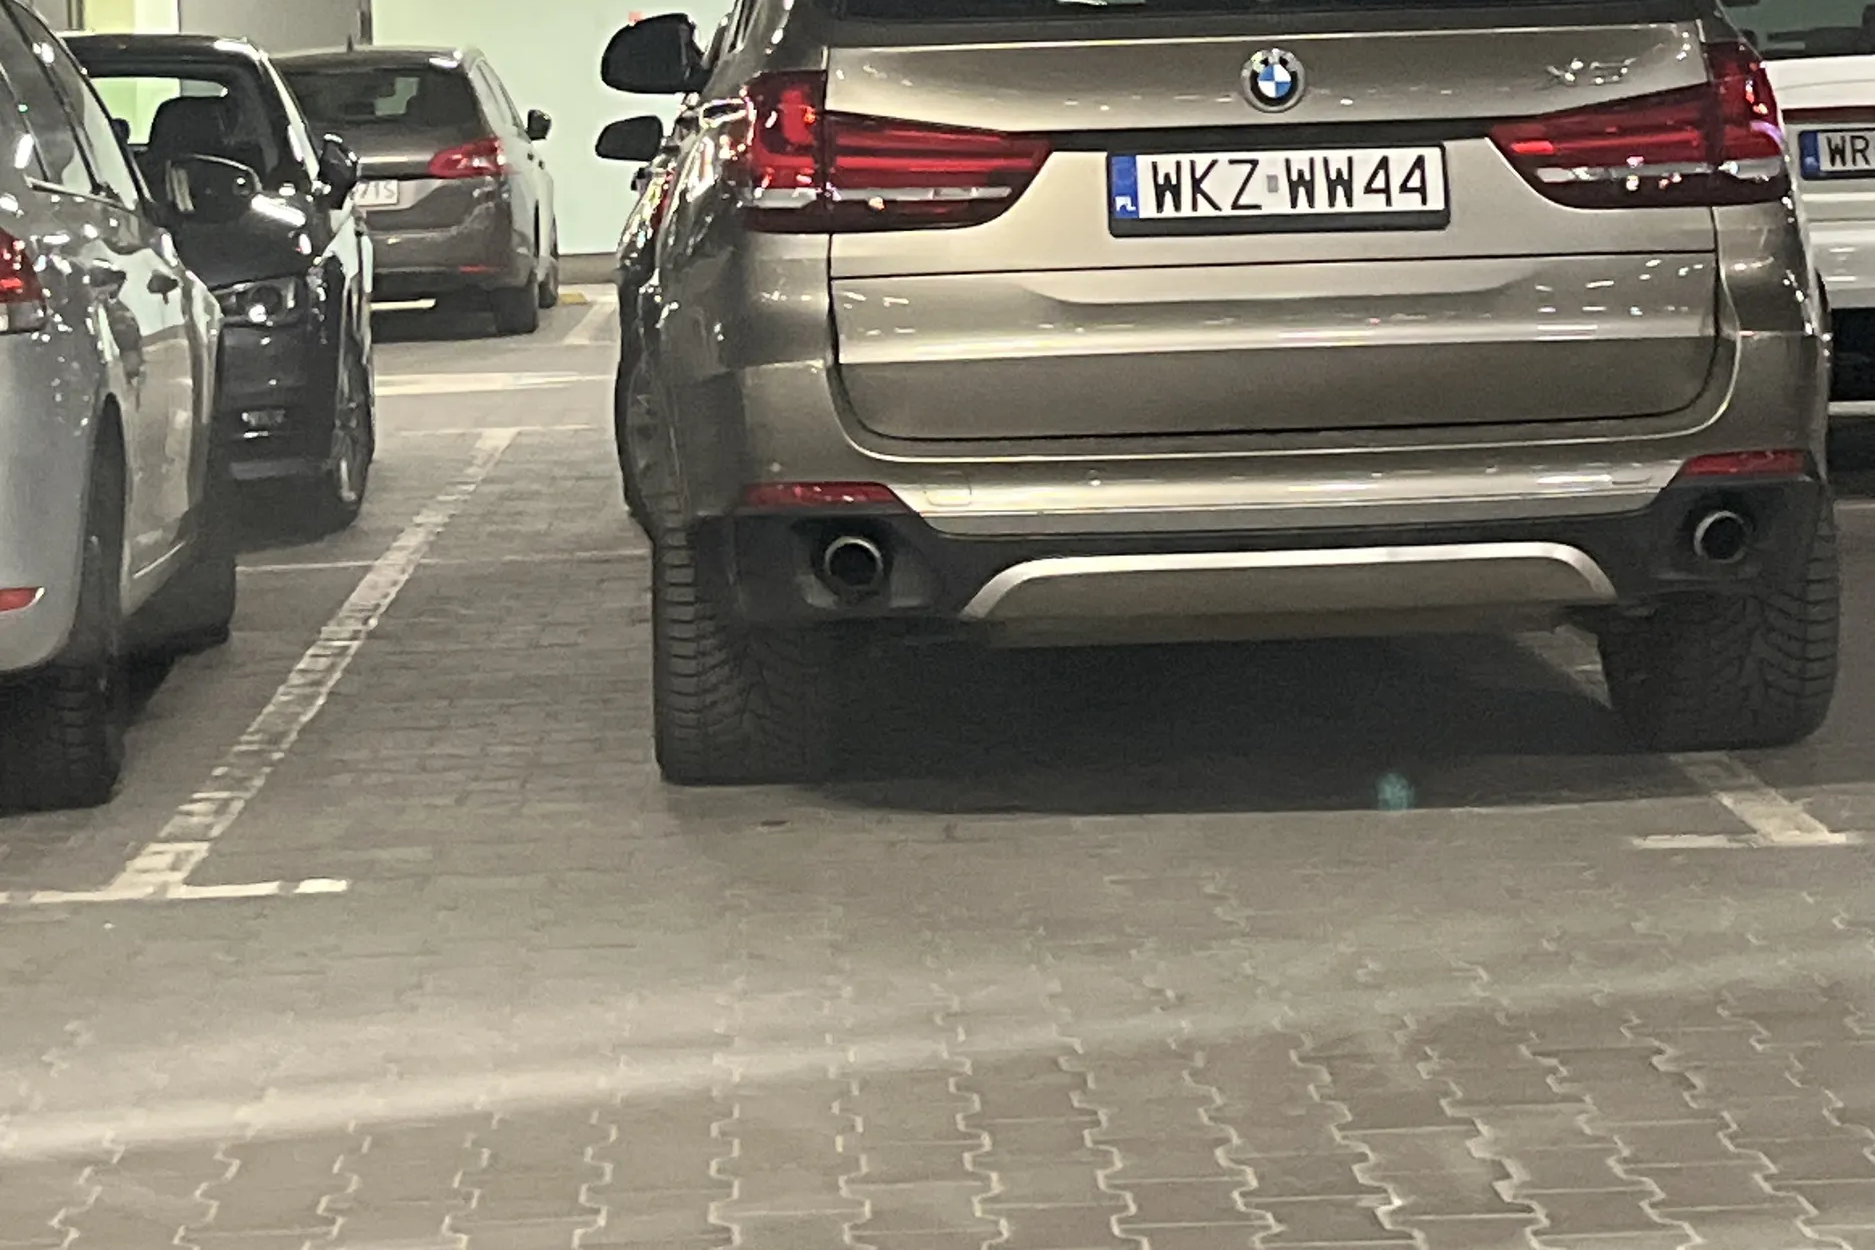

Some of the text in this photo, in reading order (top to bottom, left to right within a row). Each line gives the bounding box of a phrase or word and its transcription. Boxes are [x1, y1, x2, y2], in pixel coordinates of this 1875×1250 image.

[1826, 135, 1871, 167] WR
[1151, 154, 1427, 213] WKZ WW44
